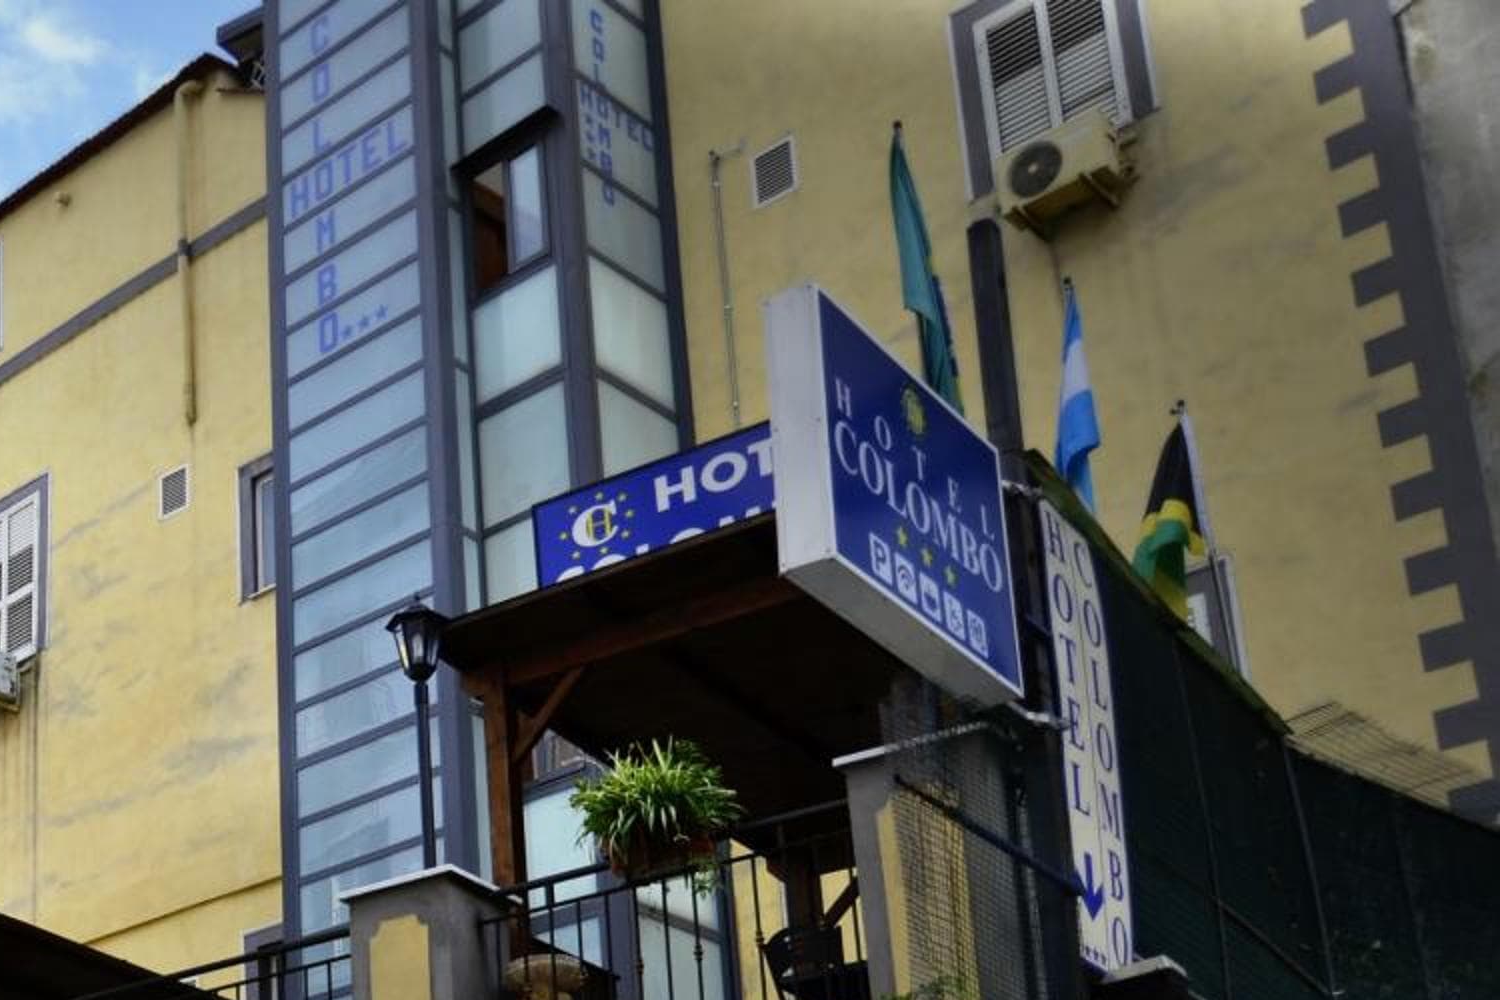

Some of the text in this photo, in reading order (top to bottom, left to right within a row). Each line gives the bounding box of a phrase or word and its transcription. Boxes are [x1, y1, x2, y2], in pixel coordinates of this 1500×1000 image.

[288, 128, 408, 220] HOTEL
[652, 437, 774, 513] HOT
[833, 420, 1003, 593] COLOMBO
[835, 377, 996, 543] HOTEL
[1043, 510, 1092, 817] HOTEL
[1073, 541, 1129, 967] COLOMBO
